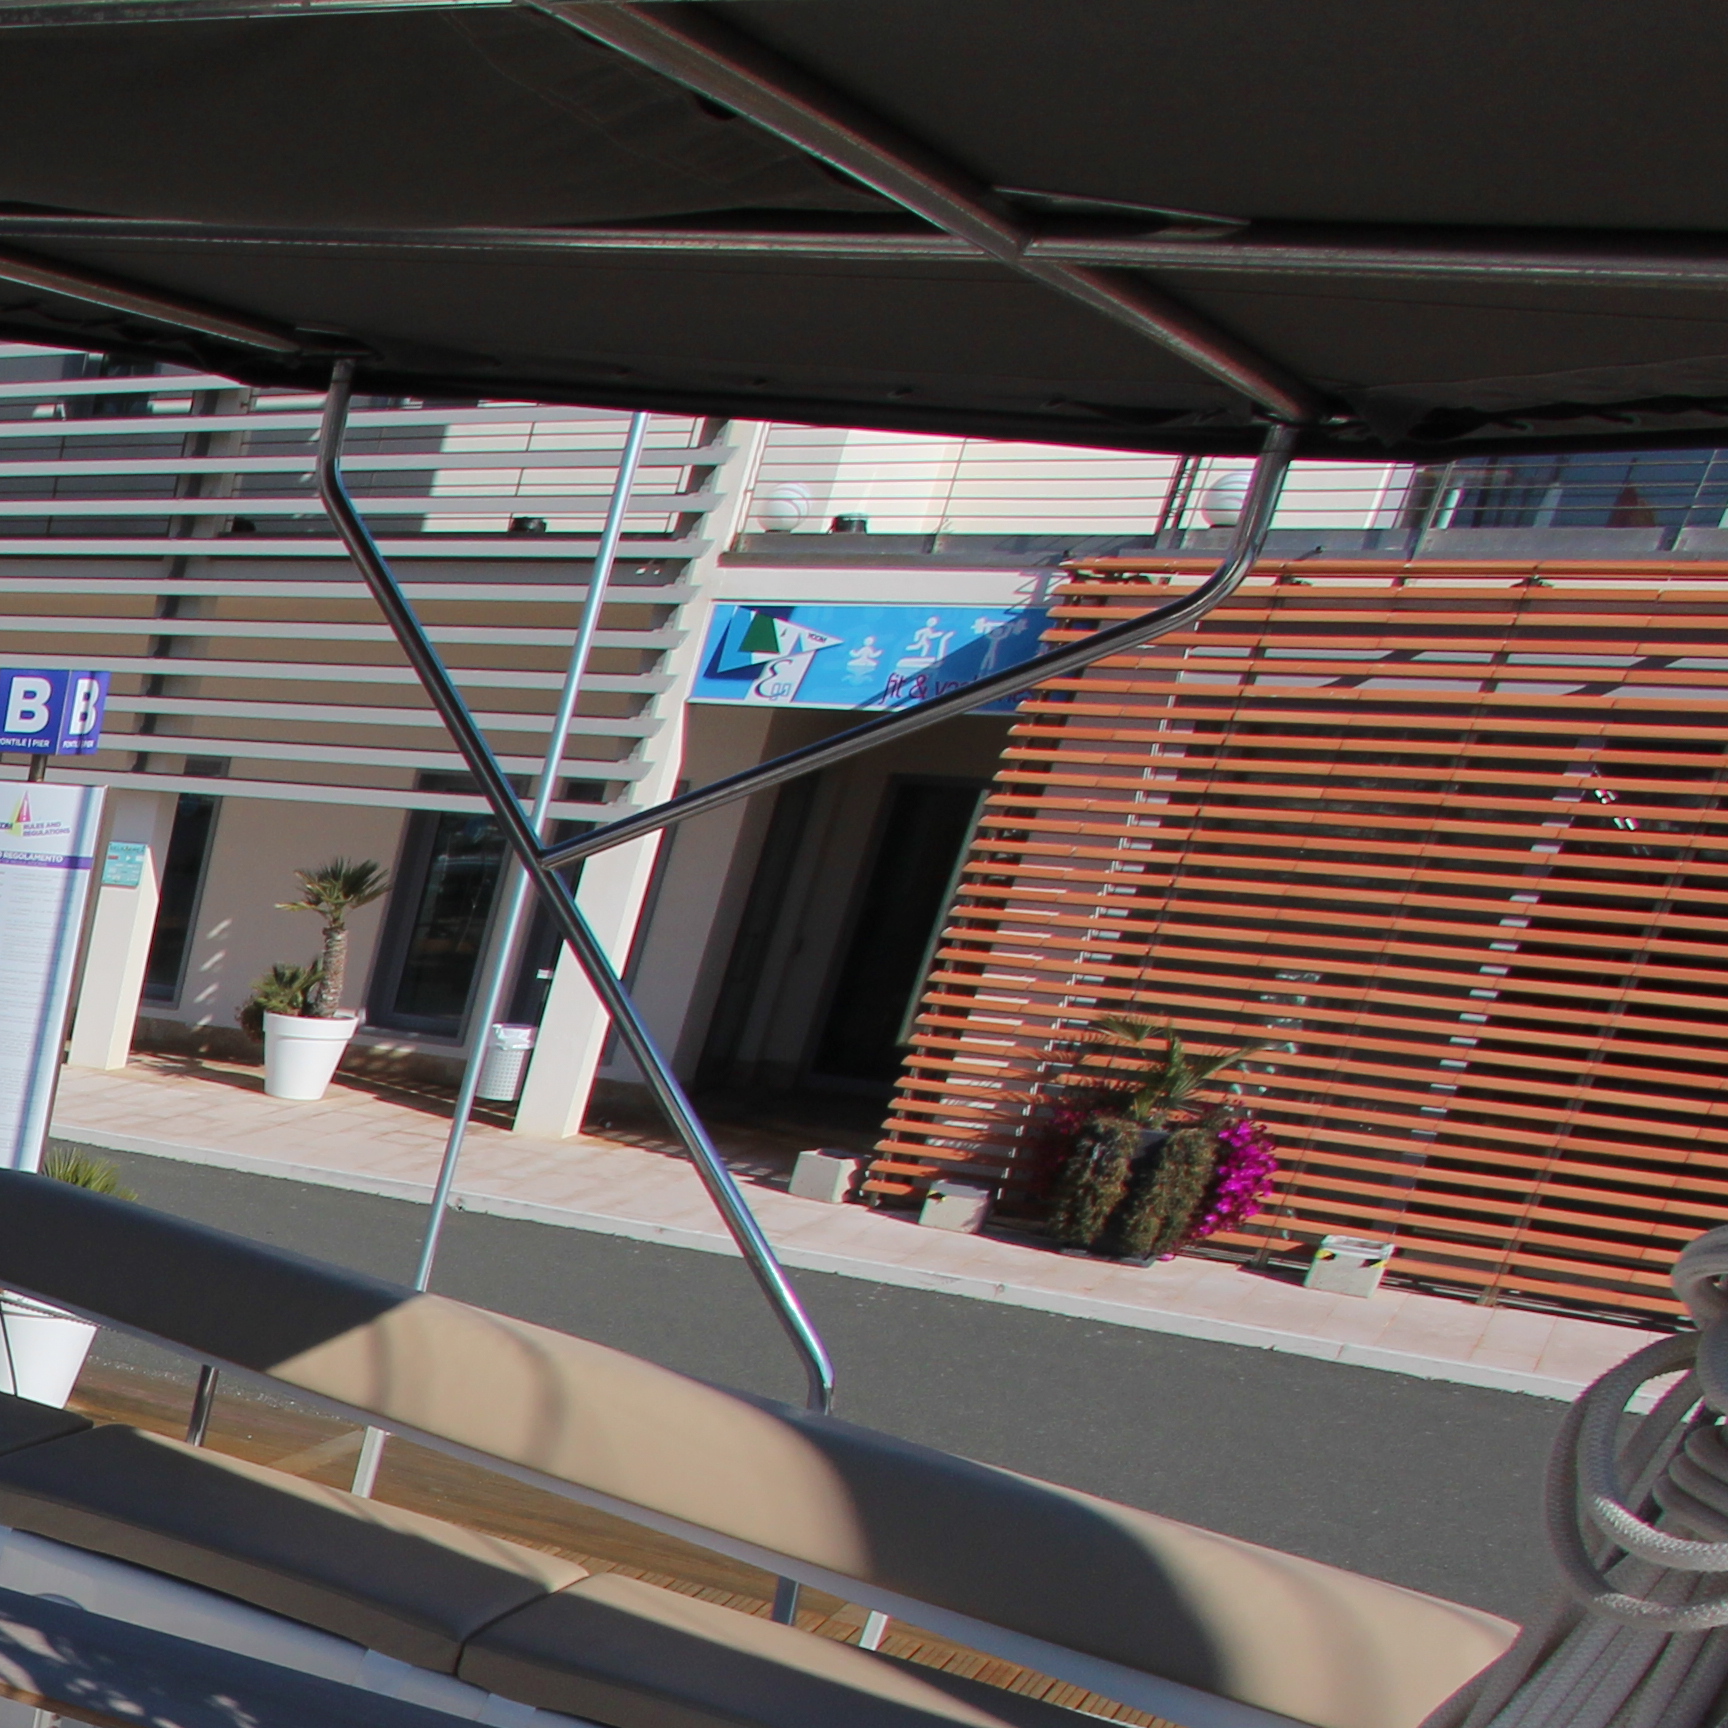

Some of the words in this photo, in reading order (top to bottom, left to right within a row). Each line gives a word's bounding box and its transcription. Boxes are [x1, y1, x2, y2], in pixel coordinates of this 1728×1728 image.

[878, 672, 906, 705] fit
[909, 673, 929, 700] &
[4, 676, 52, 734] B
[69, 678, 100, 736] B
[32, 739, 51, 748] PIER
[23, 828, 71, 837] REGULATIONS
[3, 850, 64, 863] REGOLAMENTO
